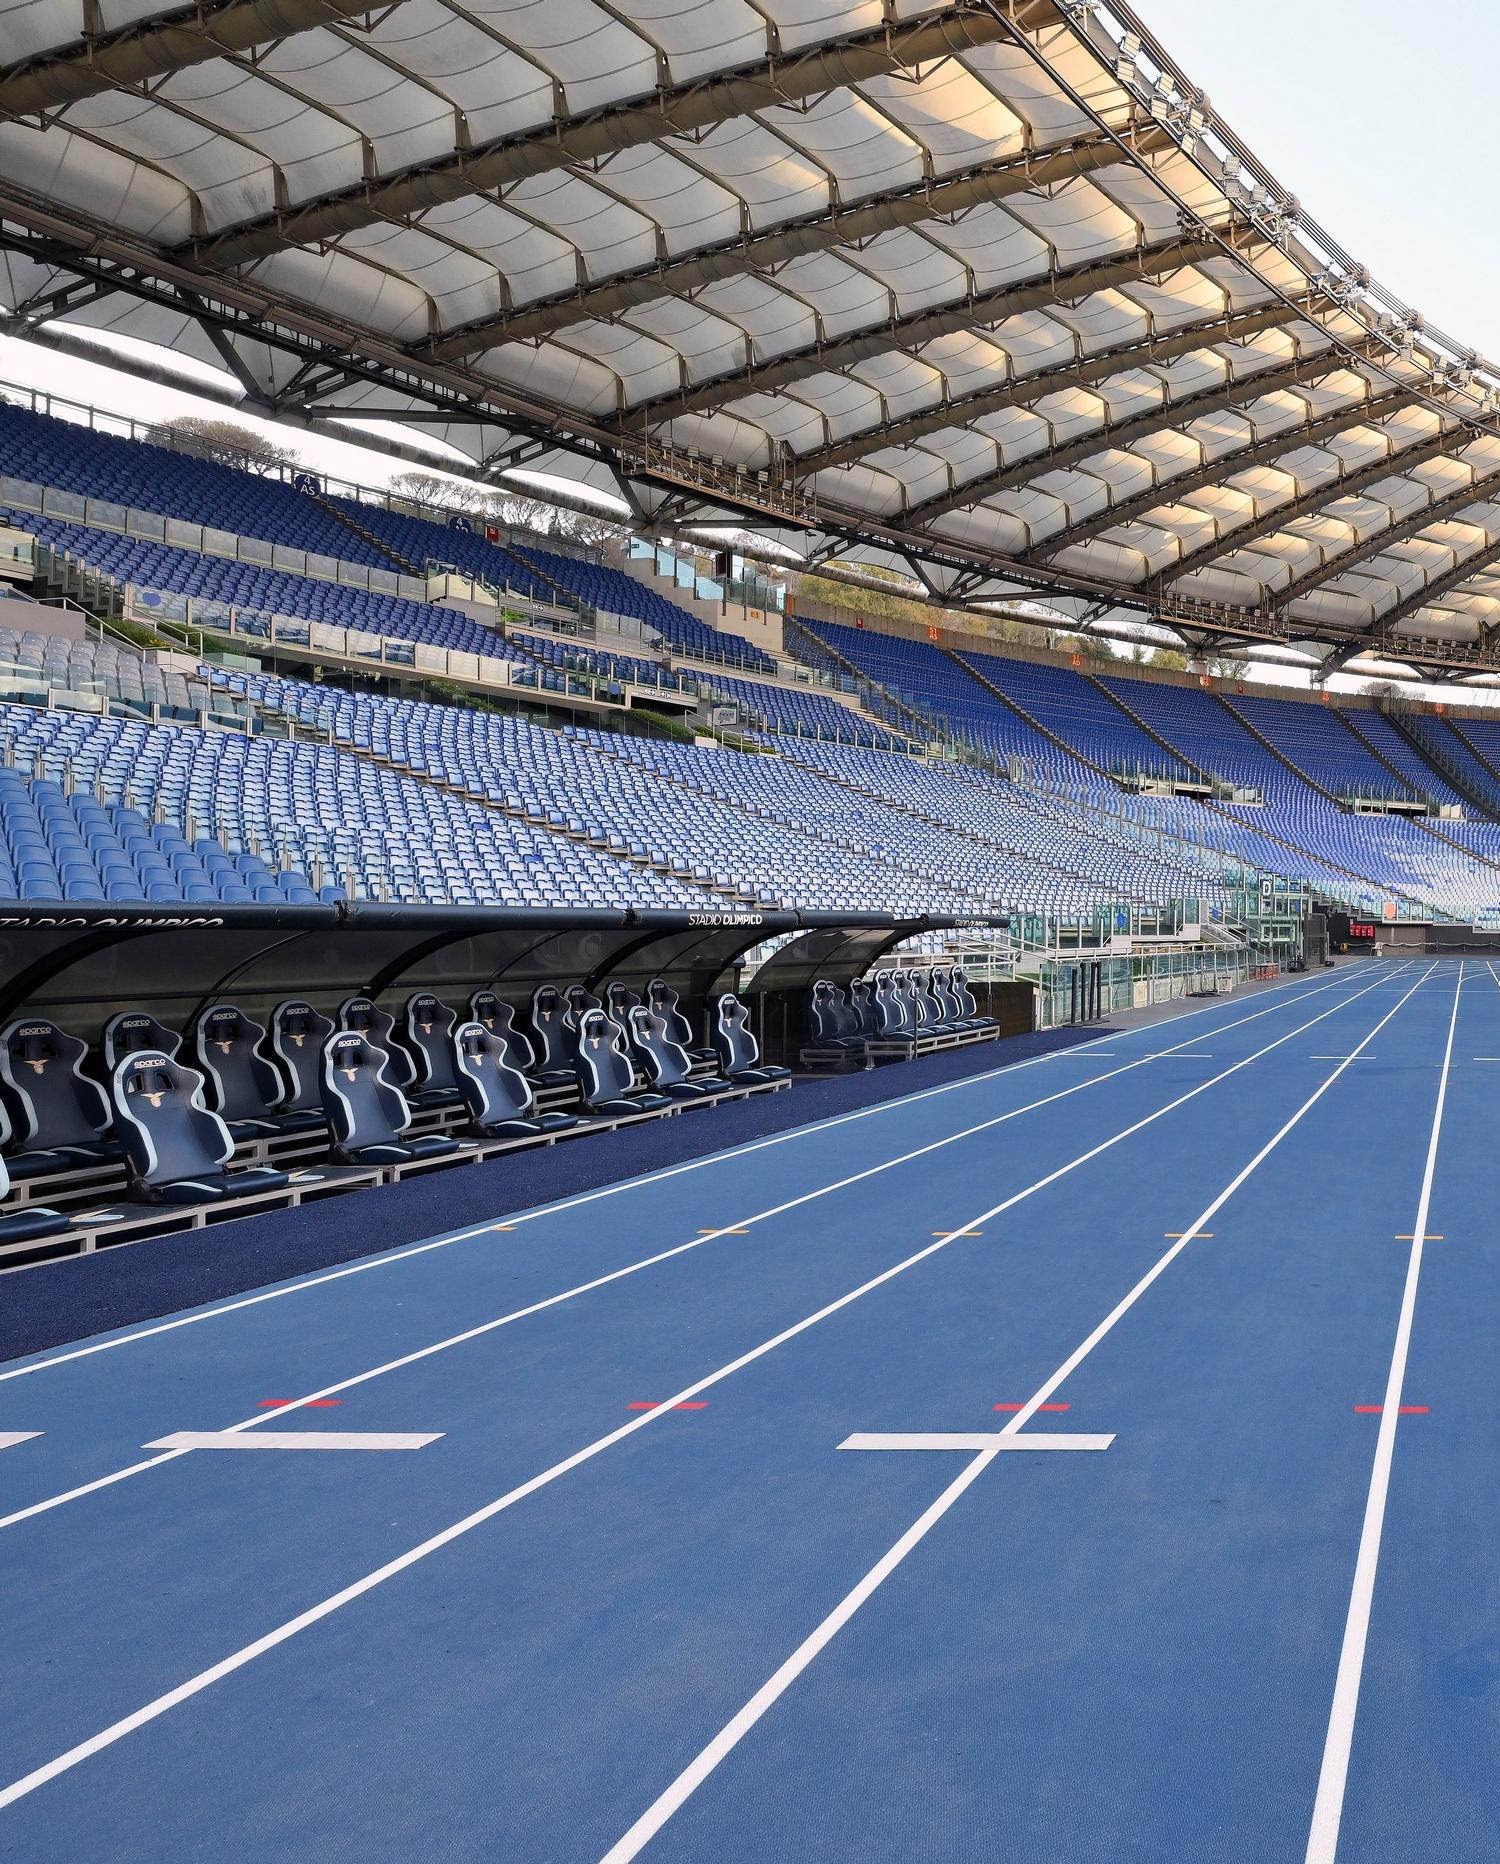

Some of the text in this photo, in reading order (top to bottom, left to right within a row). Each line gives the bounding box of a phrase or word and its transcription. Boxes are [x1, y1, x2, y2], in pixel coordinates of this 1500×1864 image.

[304, 476, 311, 484] 4
[300, 484, 316, 496] AS
[456, 518, 462, 526] 4
[1262, 881, 1272, 896] D
[688, 914, 762, 926] STADIO OLIMPICO
[213, 1012, 237, 1020] sparco
[122, 1020, 150, 1028] sparco
[19, 1026, 52, 1036] sparco
[338, 1039, 361, 1048] sparco
[134, 1059, 166, 1069] sparco
